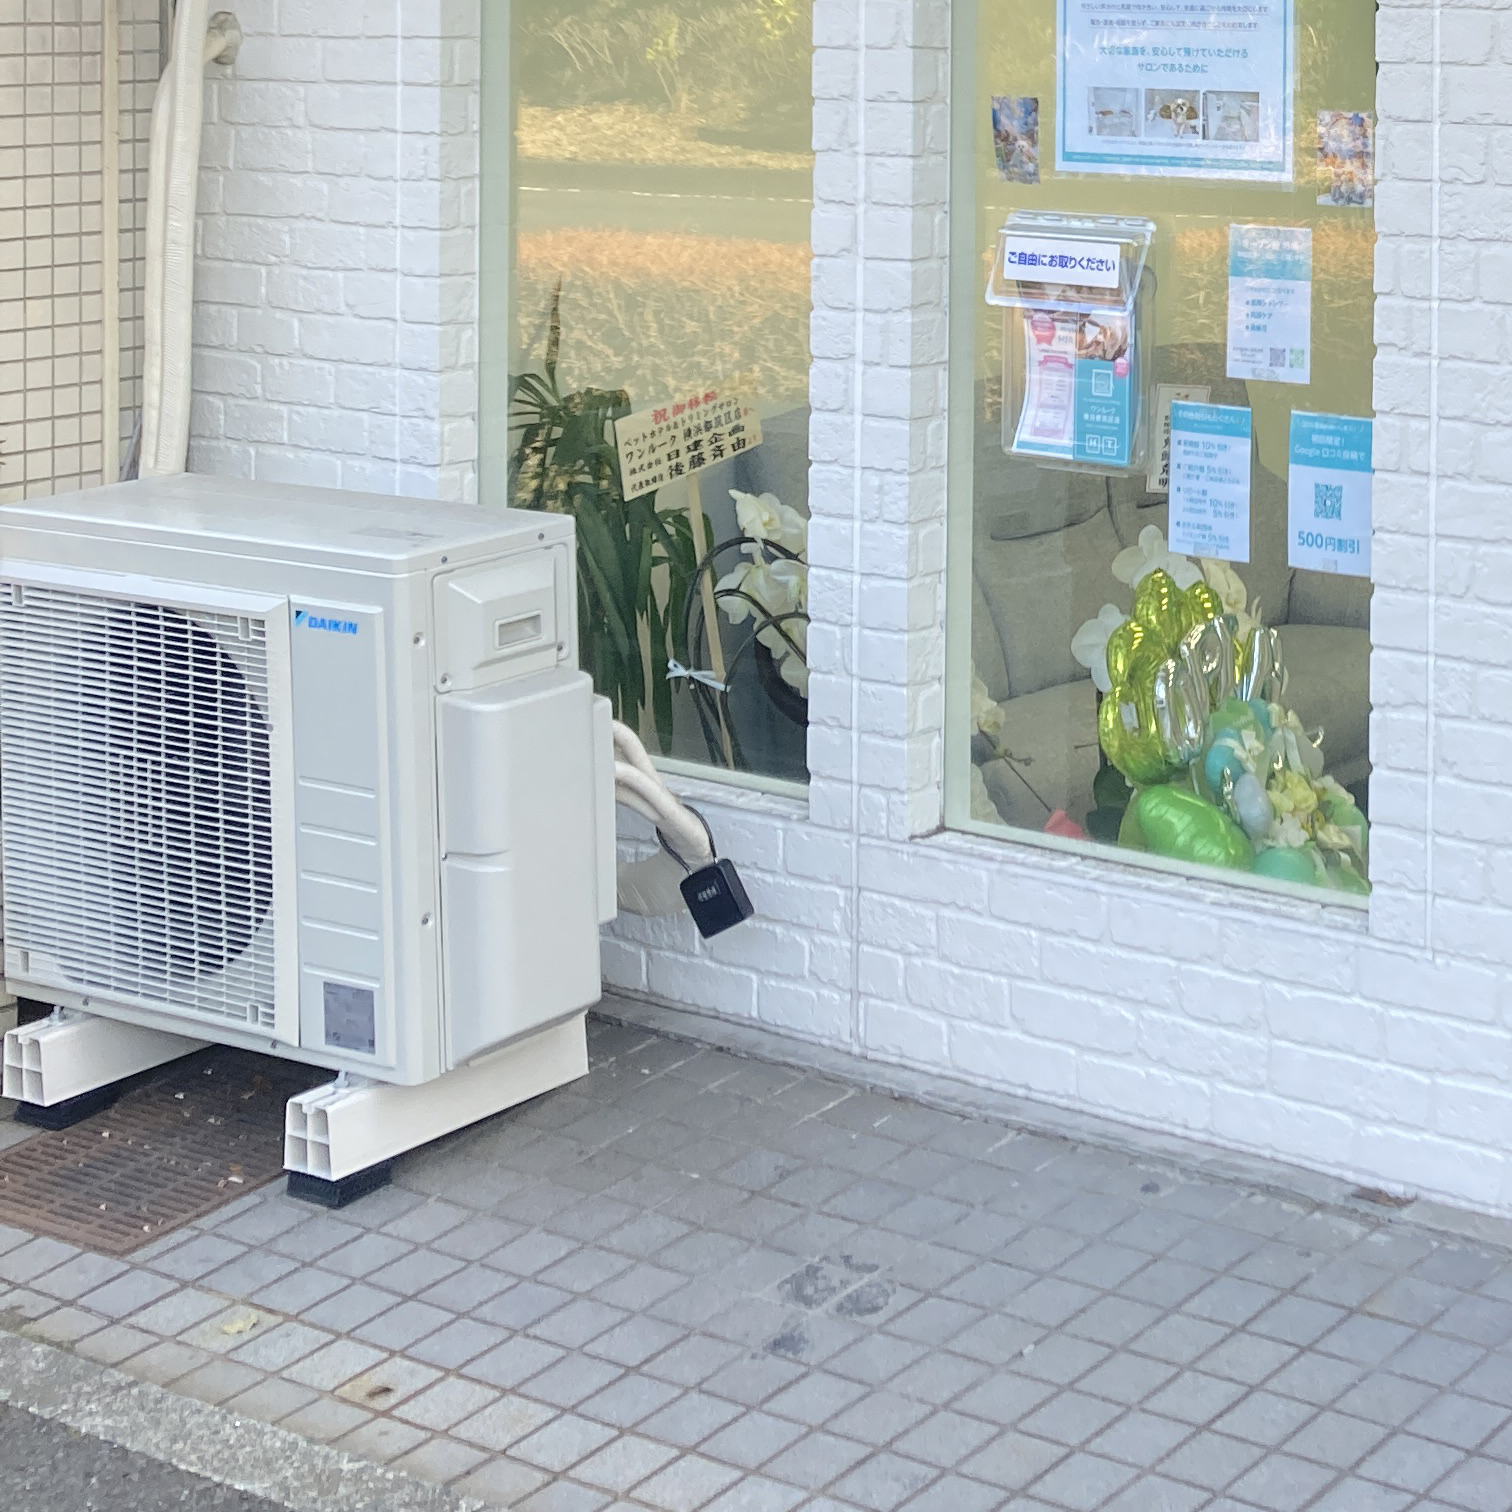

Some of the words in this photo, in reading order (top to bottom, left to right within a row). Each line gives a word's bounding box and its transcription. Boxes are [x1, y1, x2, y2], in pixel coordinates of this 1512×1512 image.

[1137, 62, 1209, 74] サロンであるために
[1007, 251, 1116, 272] ご自由にお取りください
[625, 435, 677, 464] ワンルーク
[1294, 444, 1320, 458] Google
[1297, 531, 1361, 555] 500円割引
[308, 616, 358, 635] DAIKIN
